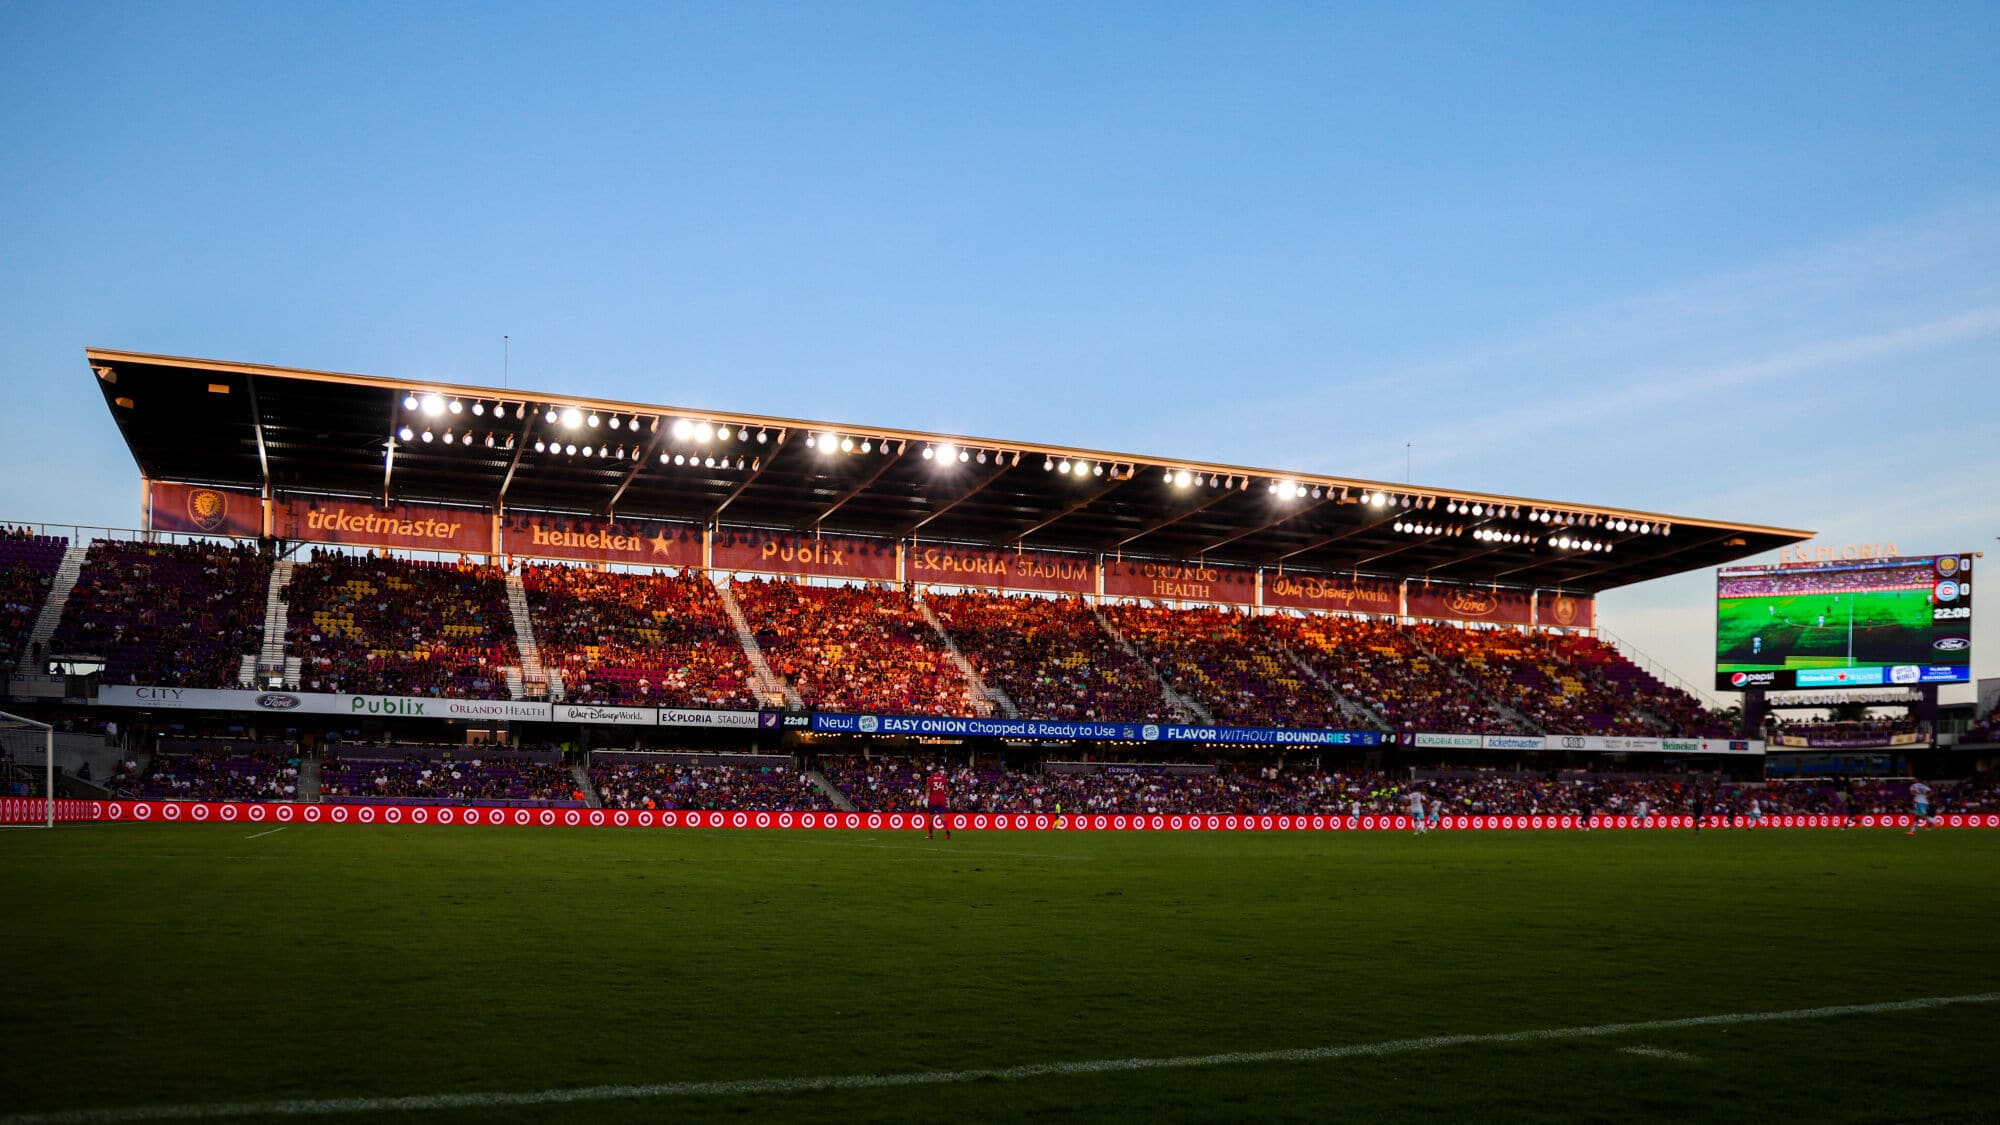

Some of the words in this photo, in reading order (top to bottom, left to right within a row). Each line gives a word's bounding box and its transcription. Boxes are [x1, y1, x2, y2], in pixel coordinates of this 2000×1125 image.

[307, 508, 460, 539] ticketmaster
[532, 525, 642, 552] Heineken
[1780, 543, 1900, 562] EXPLORIA
[913, 549, 1008, 576] EXPLORIA
[1017, 560, 1088, 582] STADIUM
[1144, 563, 1218, 583] ORLANDO
[1152, 580, 1210, 598] HEALTH
[1747, 672, 1774, 682] pepsi
[136, 687, 184, 700] CITY
[1770, 693, 1850, 705] EXPLORIA
[264, 696, 292, 708] Ford
[351, 696, 425, 715] Publix
[450, 704, 501, 715] ORLANDO
[505, 705, 545, 717] HEALTH
[662, 712, 712, 724] EXPLORIA
[717, 714, 756, 726] STADIUM
[818, 716, 853, 729] New!
[884, 718, 919, 731] EASY
[922, 720, 966, 732] ONION
[969, 723, 1025, 738] Chopped
[1028, 724, 1036, 735] &
[1039, 723, 1076, 738] Ready
[1079, 726, 1092, 736] to
[1095, 725, 1115, 737] Use
[1168, 728, 1216, 741] FLAVOR
[1217, 729, 1275, 742] WITHOUT
[1277, 731, 1351, 743] BOUNDARIES
[1488, 737, 1541, 748] ticketmaster
[1662, 741, 1698, 751] Heineken
[932, 781, 945, 791] 34
